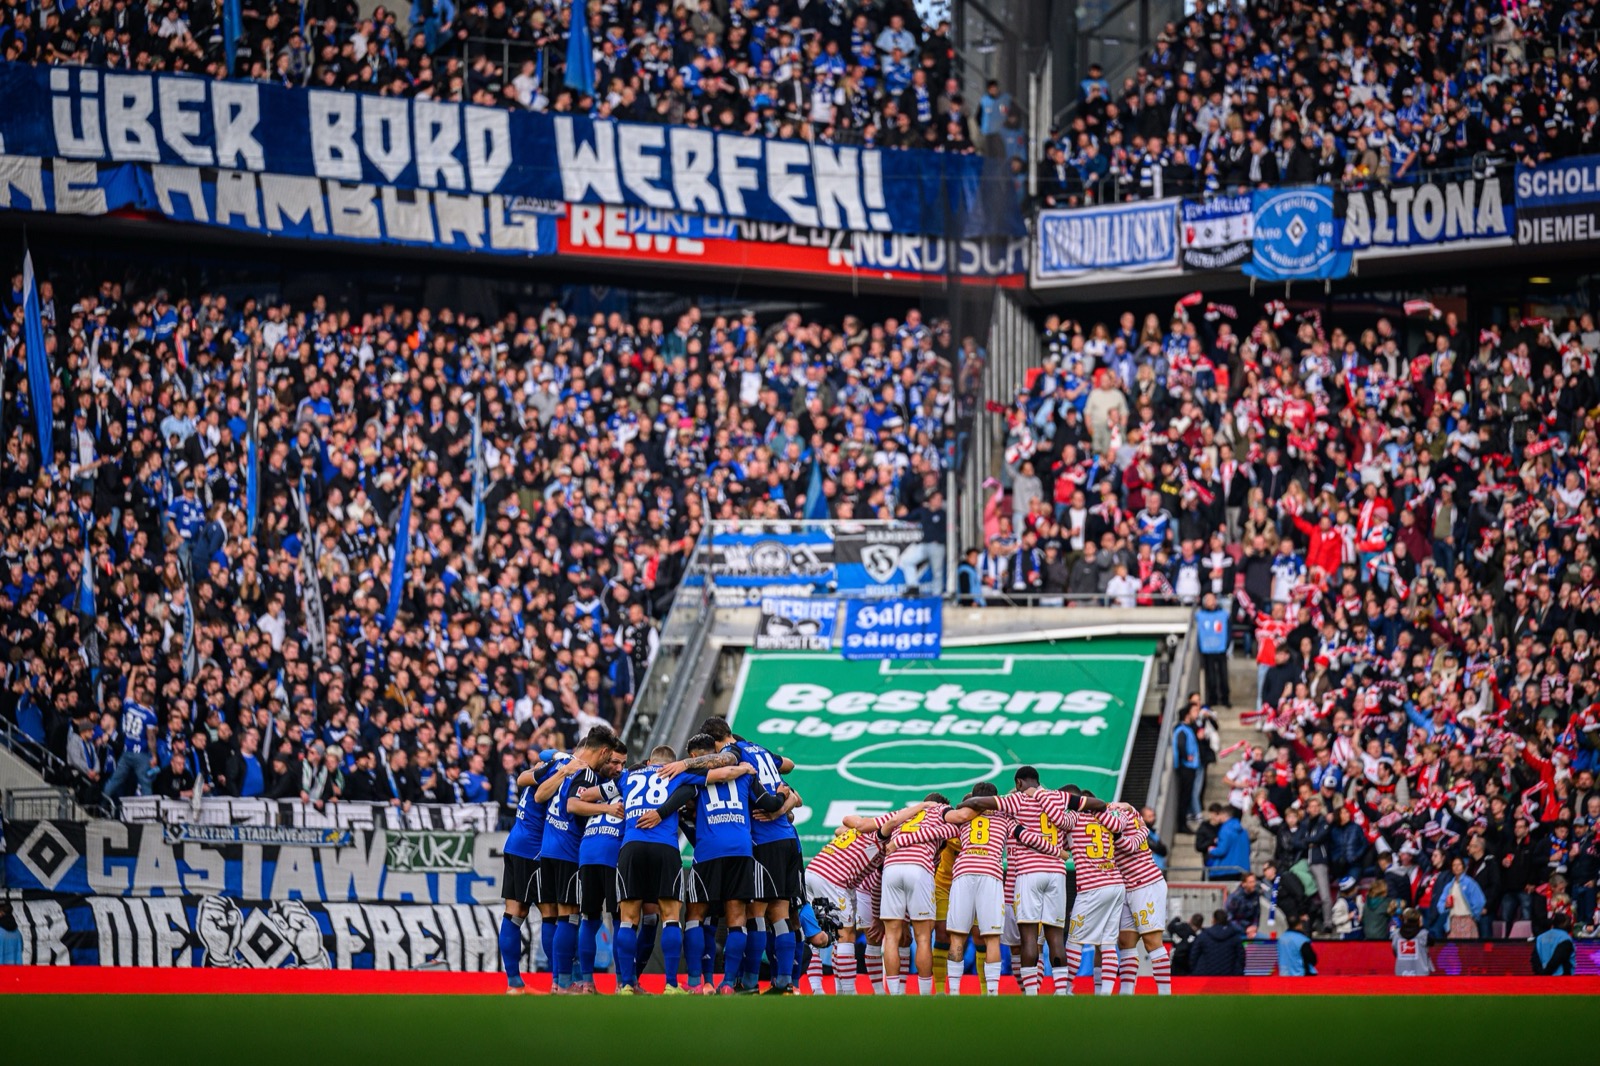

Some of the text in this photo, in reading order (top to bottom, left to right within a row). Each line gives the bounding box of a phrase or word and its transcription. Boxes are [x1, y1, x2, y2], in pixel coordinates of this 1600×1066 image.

[50, 68, 892, 231] ÜBER BORD WERFEN!
[1342, 178, 1507, 246] ALTONA
[1044, 208, 1172, 267] NORDHAUSEN
[766, 683, 1113, 713] Bestens
[757, 714, 1107, 740] abgesichert
[755, 753, 781, 792] 44
[625, 774, 670, 809] 28
[706, 778, 743, 812] 11
[970, 816, 990, 845] 8
